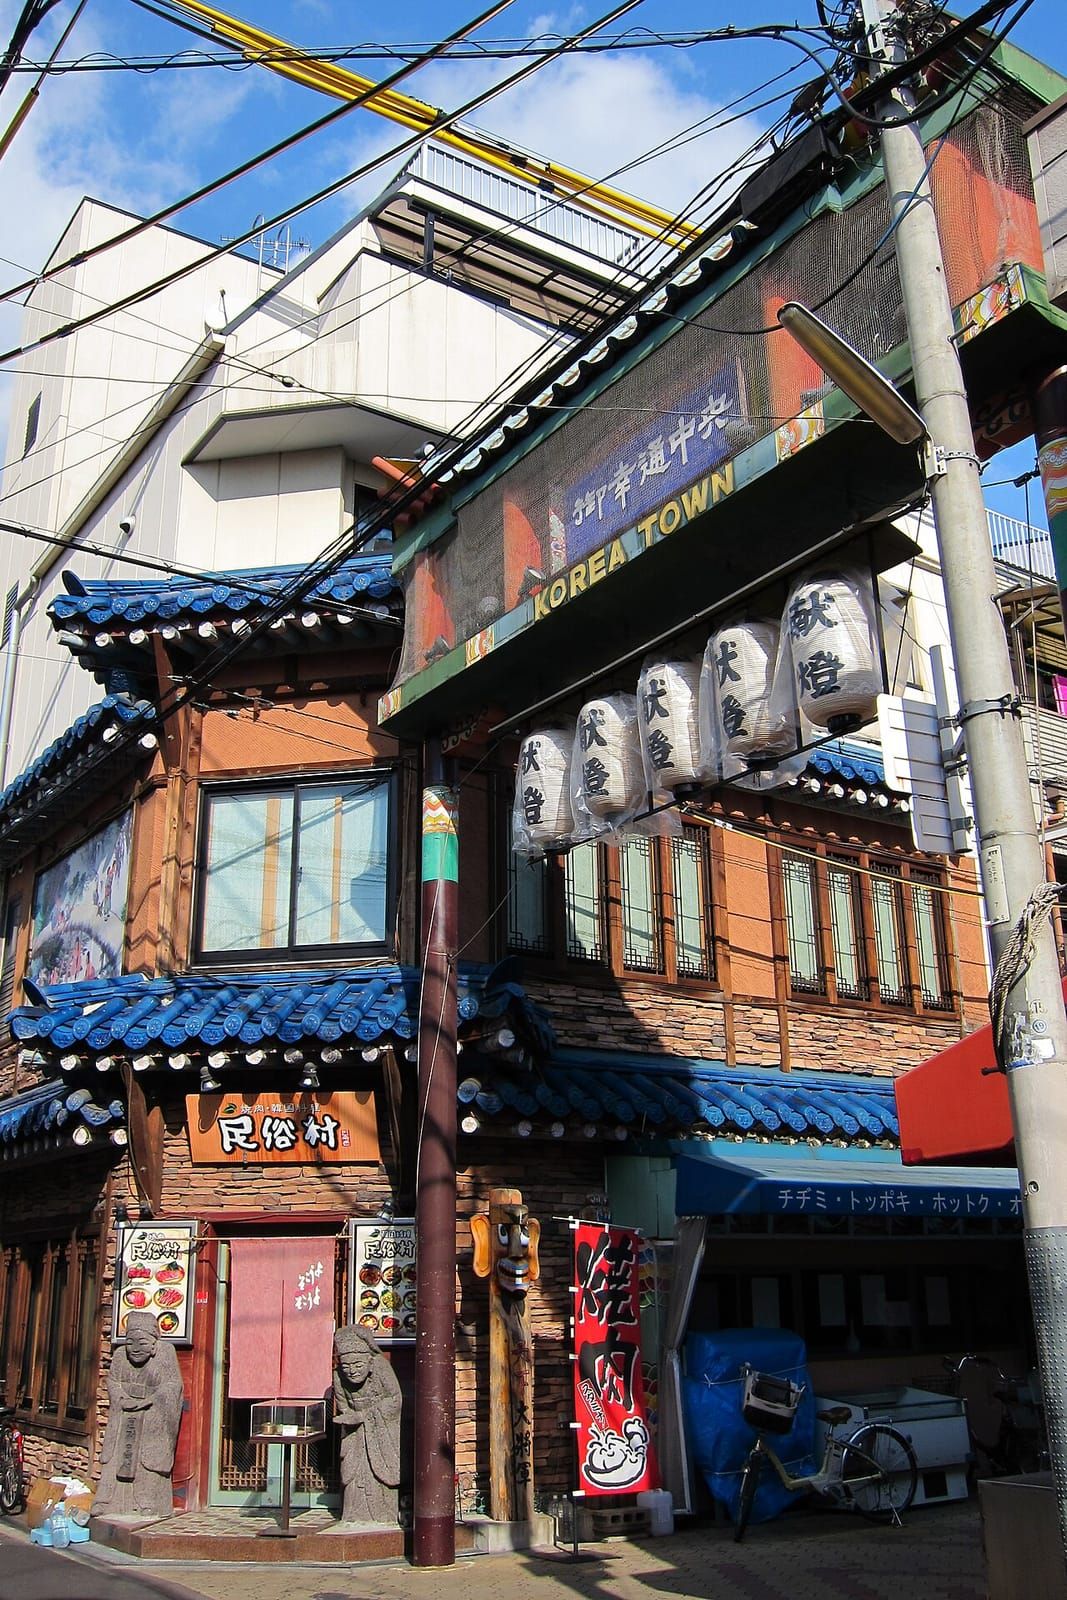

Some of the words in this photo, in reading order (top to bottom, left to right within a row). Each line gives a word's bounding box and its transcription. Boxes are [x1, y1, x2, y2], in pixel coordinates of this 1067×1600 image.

[573, 393, 733, 526] 御幸通中央
[534, 542, 627, 620] KOREA
[638, 460, 735, 549] TOWN
[218, 1114, 340, 1153] 民俗村
[130, 1241, 180, 1261] 民俗村
[364, 1239, 415, 1260] 民俗村
[576, 1231, 639, 1414] 焼肉
